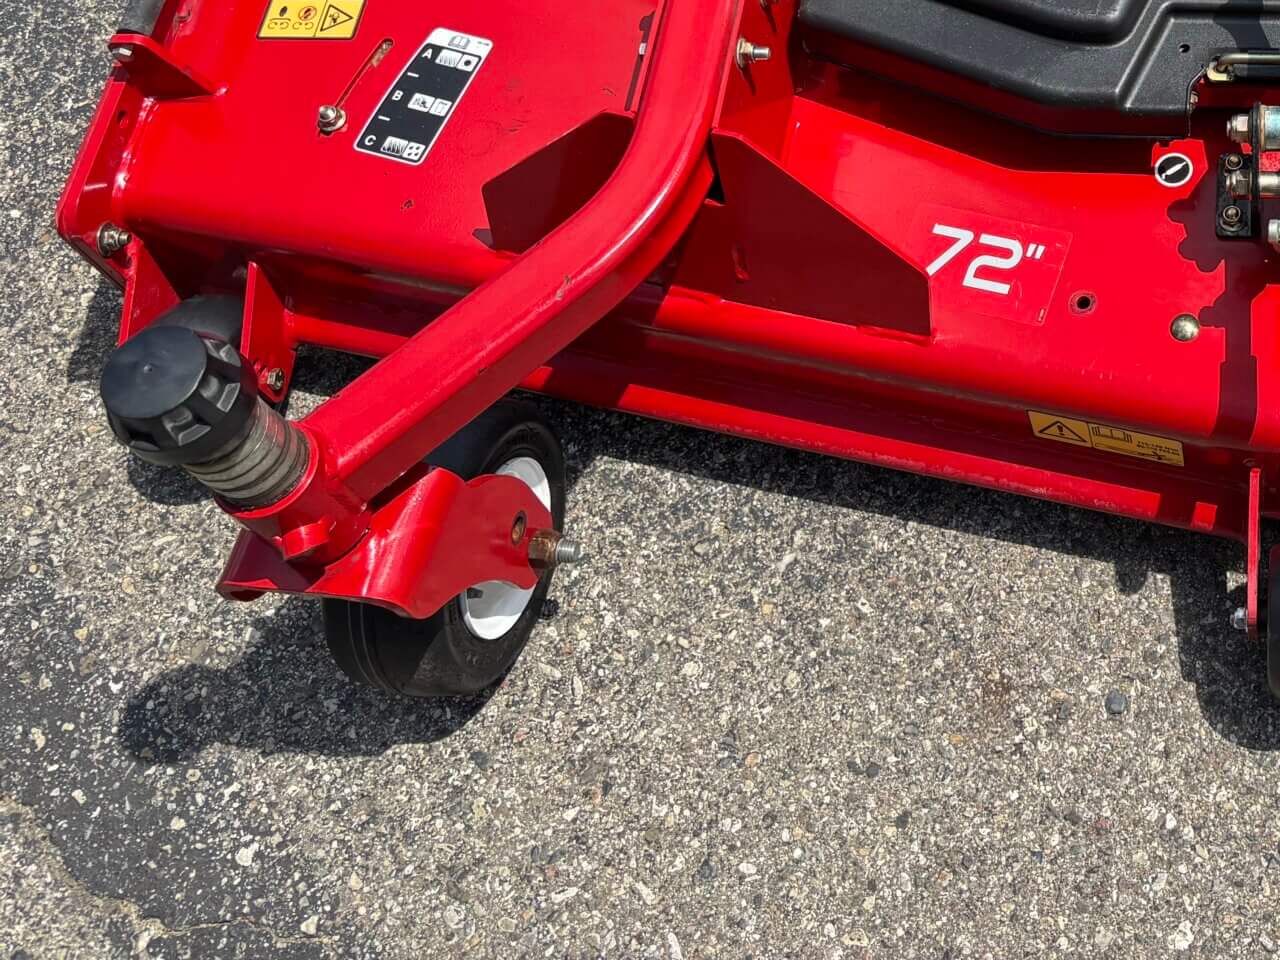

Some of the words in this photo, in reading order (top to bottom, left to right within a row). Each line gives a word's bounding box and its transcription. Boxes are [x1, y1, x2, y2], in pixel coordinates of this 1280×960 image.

[422, 48, 433, 59] A
[392, 90, 404, 101] B
[364, 135, 376, 146] C
